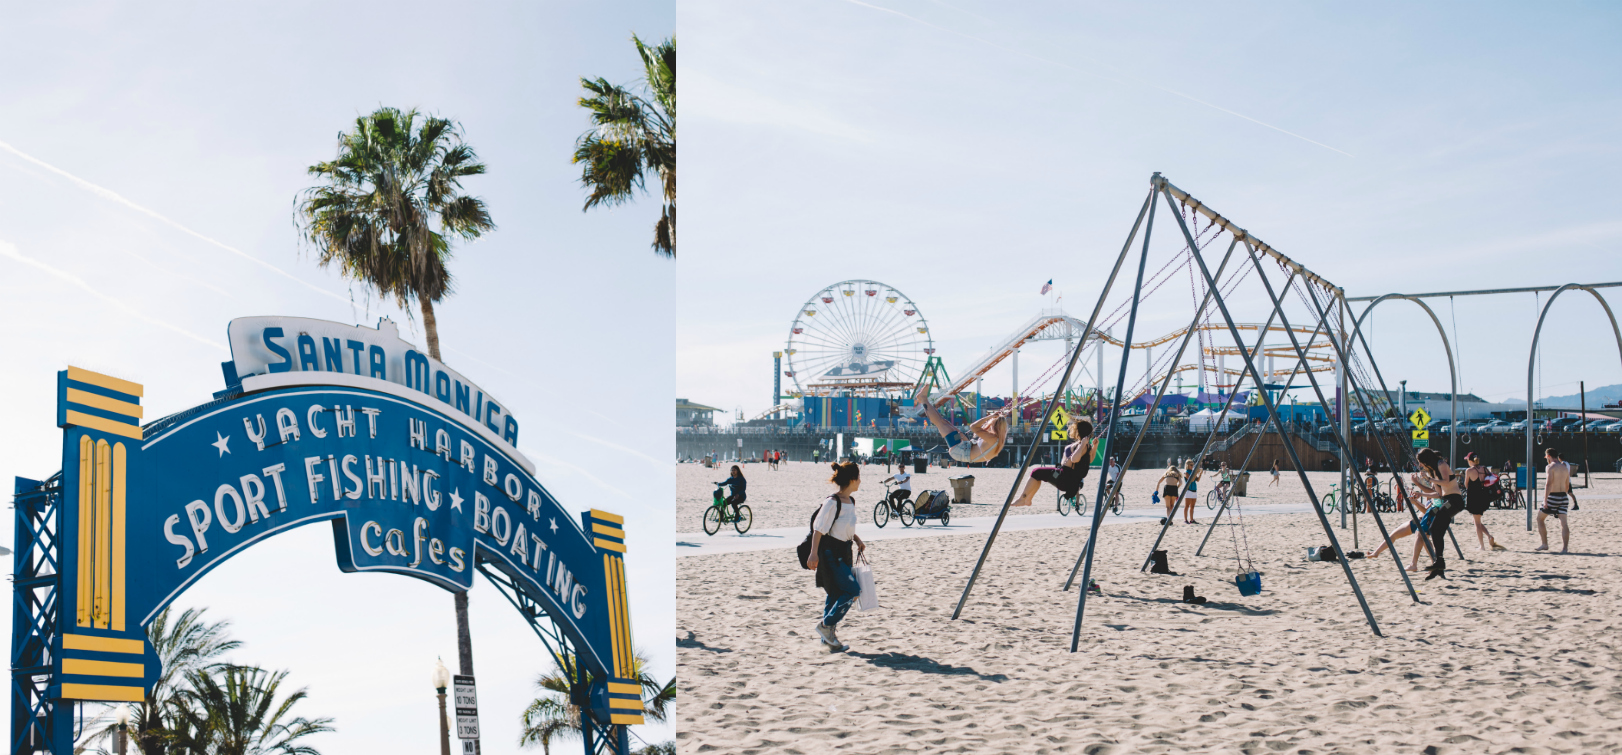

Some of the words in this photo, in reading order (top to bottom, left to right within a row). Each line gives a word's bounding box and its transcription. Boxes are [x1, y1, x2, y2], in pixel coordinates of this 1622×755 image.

[262, 327, 386, 380] SANTA
[404, 350, 518, 449] MONICA
[243, 404, 382, 451] YACHT
[409, 417, 542, 522] HARBOR
[163, 462, 288, 570] SPORT
[304, 454, 442, 511] FISHING
[474, 490, 588, 619] BOATING
[456, 696, 462, 704] 10
[463, 696, 475, 705] TONS
[459, 726, 463, 734] 3
[464, 726, 477, 735] TONS
[464, 741, 473, 753] NO
